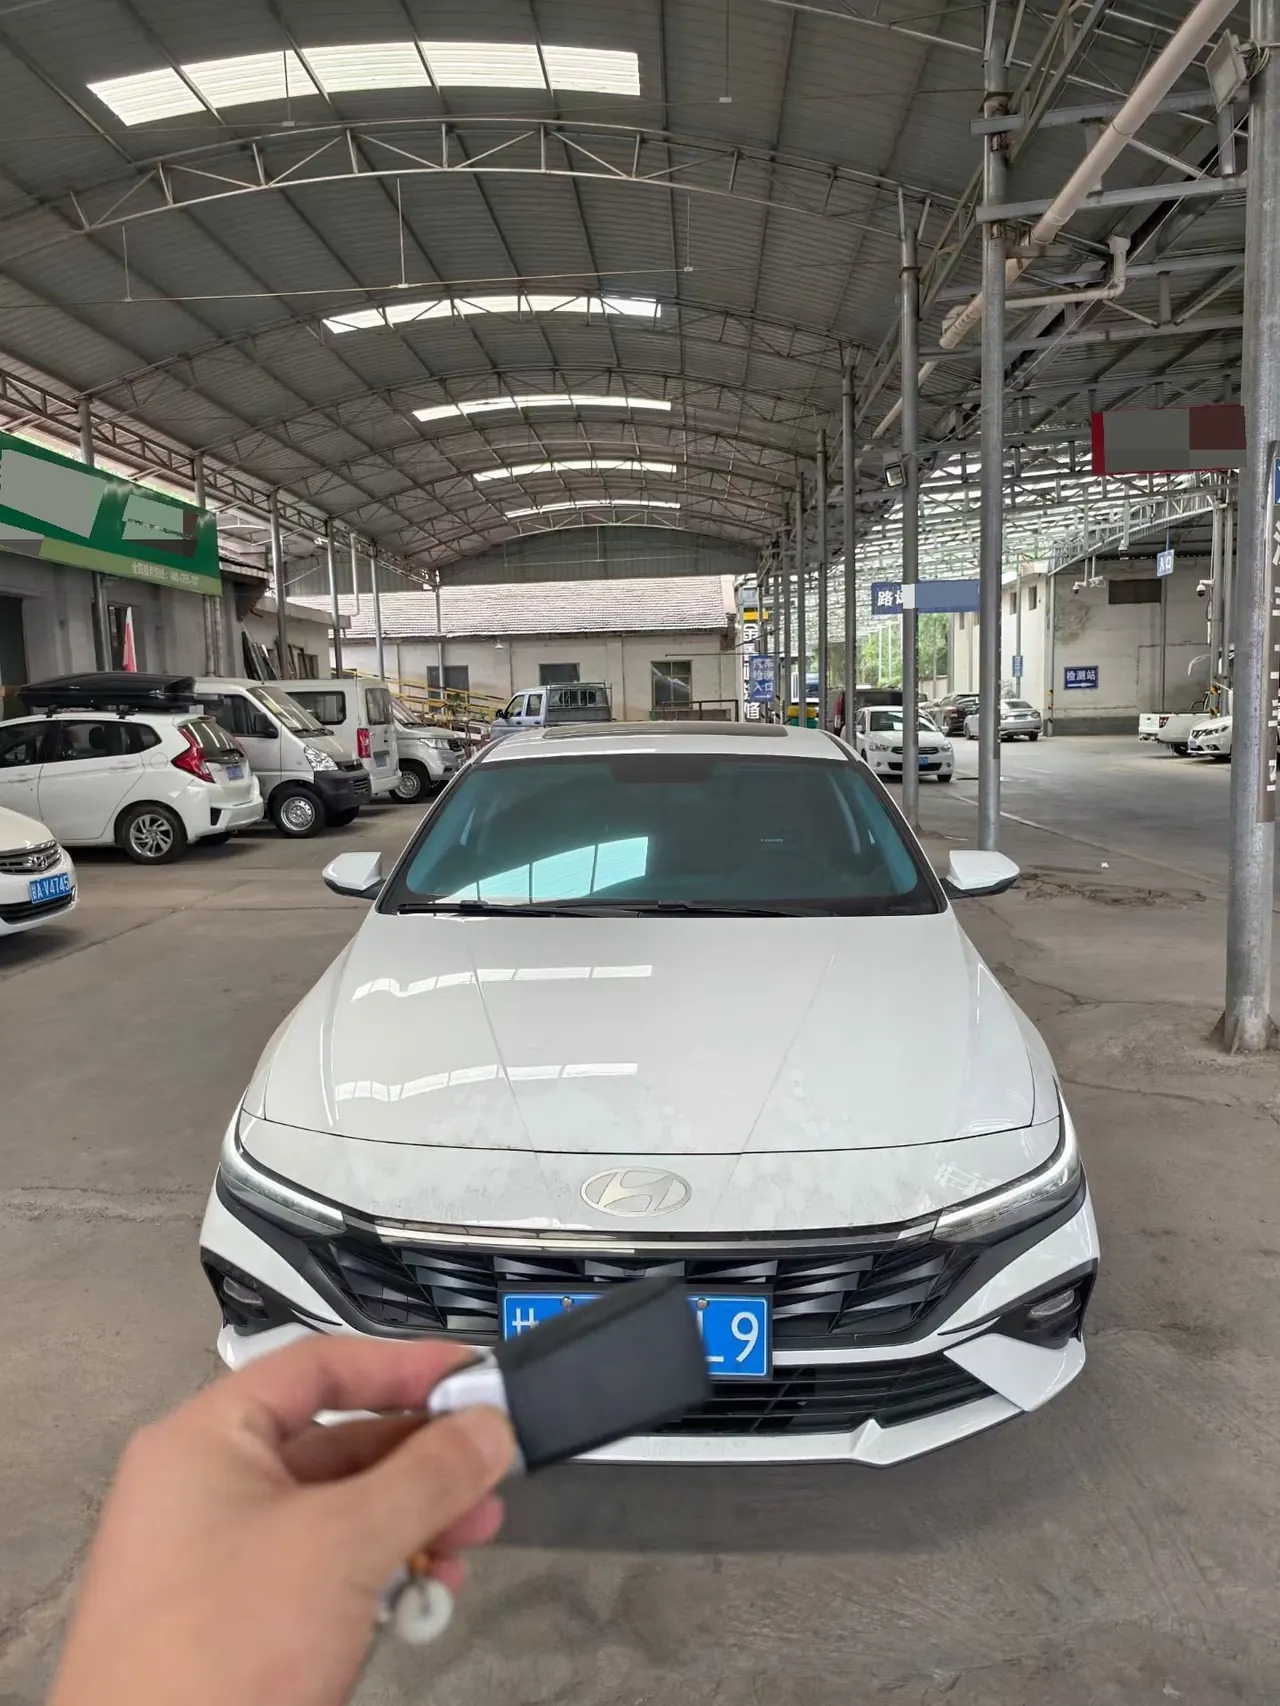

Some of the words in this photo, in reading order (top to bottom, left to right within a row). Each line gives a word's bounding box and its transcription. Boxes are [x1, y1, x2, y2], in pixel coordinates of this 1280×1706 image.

[1158, 555, 1173, 573] 入口
[752, 658, 774, 669] 汽车
[752, 670, 774, 680] 检测
[1066, 669, 1096, 681] 检测站
[753, 682, 773, 691] 入口
